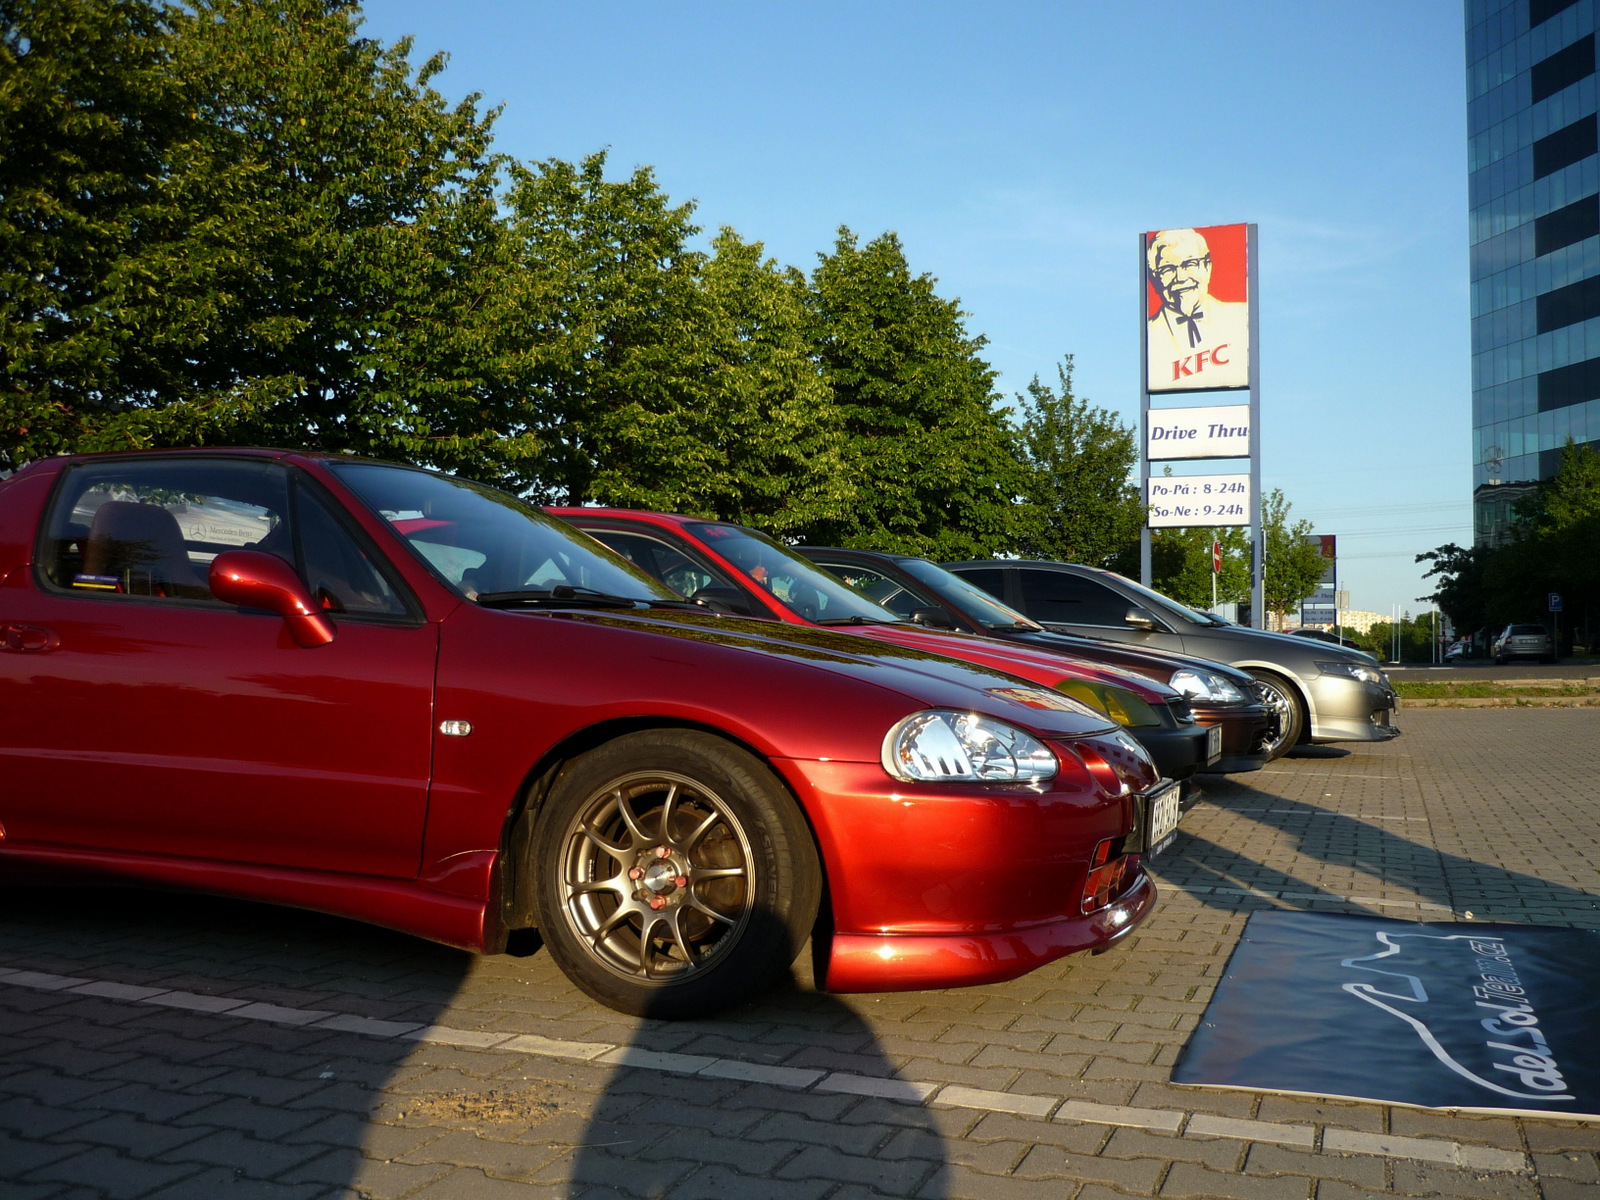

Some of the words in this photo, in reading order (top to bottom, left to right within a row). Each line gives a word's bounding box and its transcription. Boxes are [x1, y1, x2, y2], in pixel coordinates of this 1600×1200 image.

[1172, 345, 1229, 381] KFC
[1151, 425, 1197, 440] Drive
[1208, 424, 1248, 438] Thru
[1552, 595, 1560, 606] P
